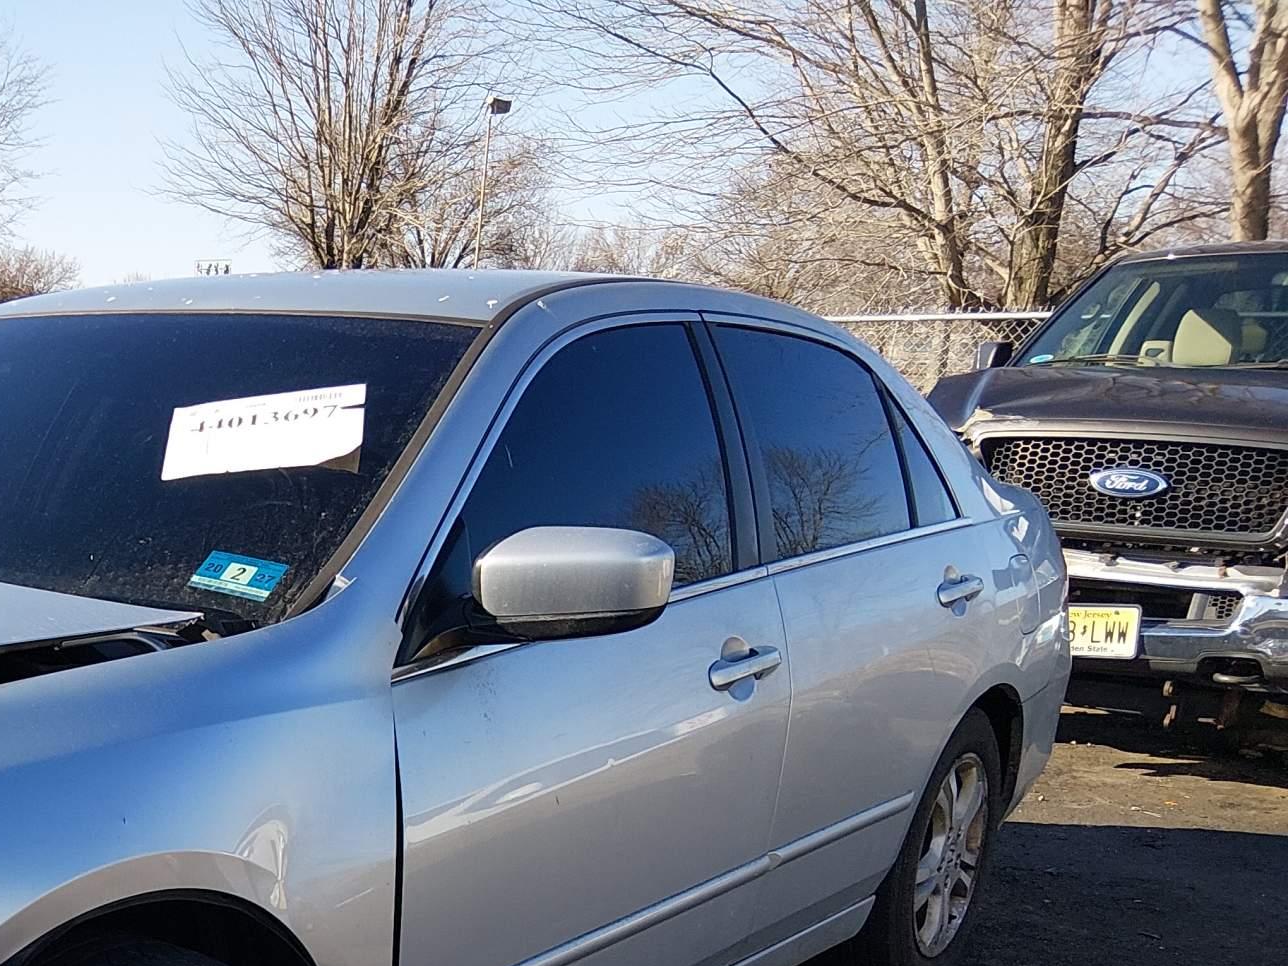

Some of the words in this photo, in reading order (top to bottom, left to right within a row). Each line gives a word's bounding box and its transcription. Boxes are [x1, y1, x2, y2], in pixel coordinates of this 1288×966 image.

[1105, 474, 1149, 491] Ford
[204, 562, 224, 574] 20
[230, 567, 247, 581] 2
